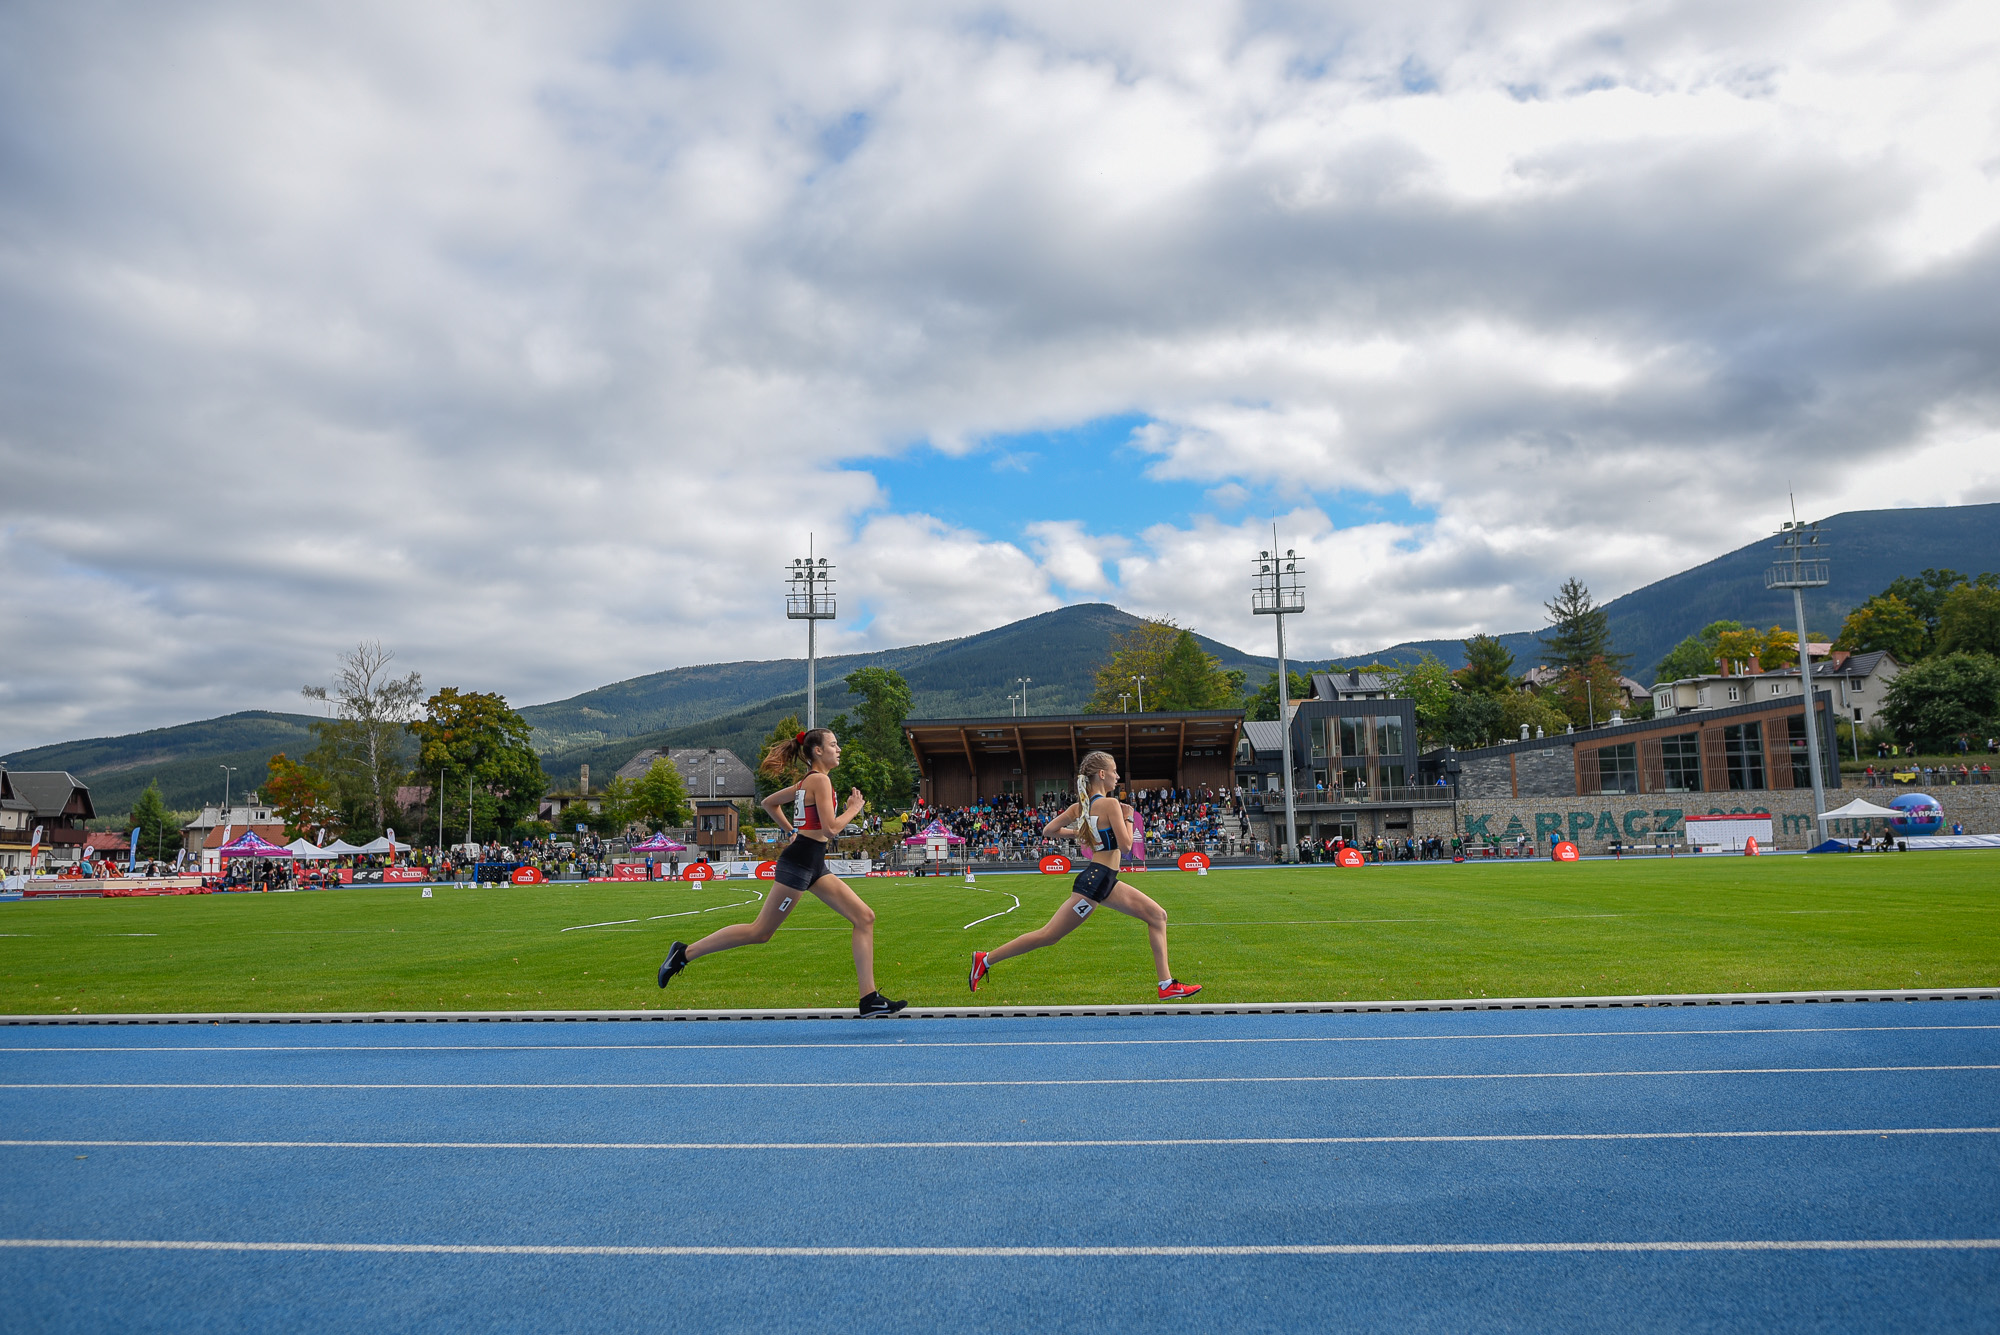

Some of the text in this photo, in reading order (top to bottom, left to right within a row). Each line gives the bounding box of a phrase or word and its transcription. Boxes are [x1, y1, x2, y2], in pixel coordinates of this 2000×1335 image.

[1464, 808, 1684, 842] KARPACZ
[353, 872, 383, 880] 4F 4F
[783, 900, 790, 910] 1
[1077, 904, 1090, 915] 4
